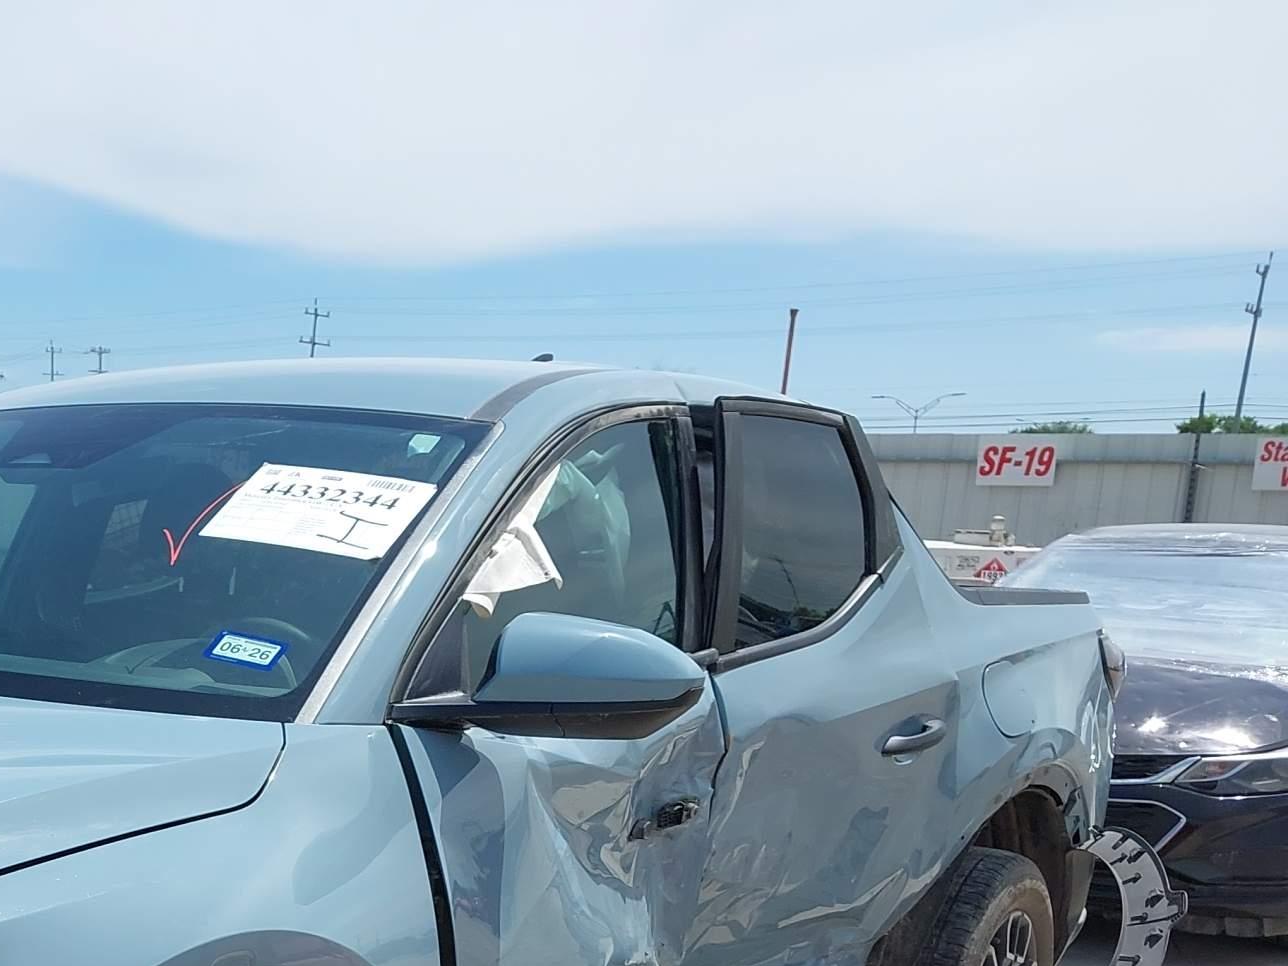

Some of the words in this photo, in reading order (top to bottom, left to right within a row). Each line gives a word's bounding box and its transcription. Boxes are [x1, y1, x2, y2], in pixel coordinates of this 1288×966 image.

[979, 446, 1055, 477] SF-19
[260, 481, 401, 511] 44332344
[219, 641, 242, 654] 06
[247, 647, 273, 661] 26
